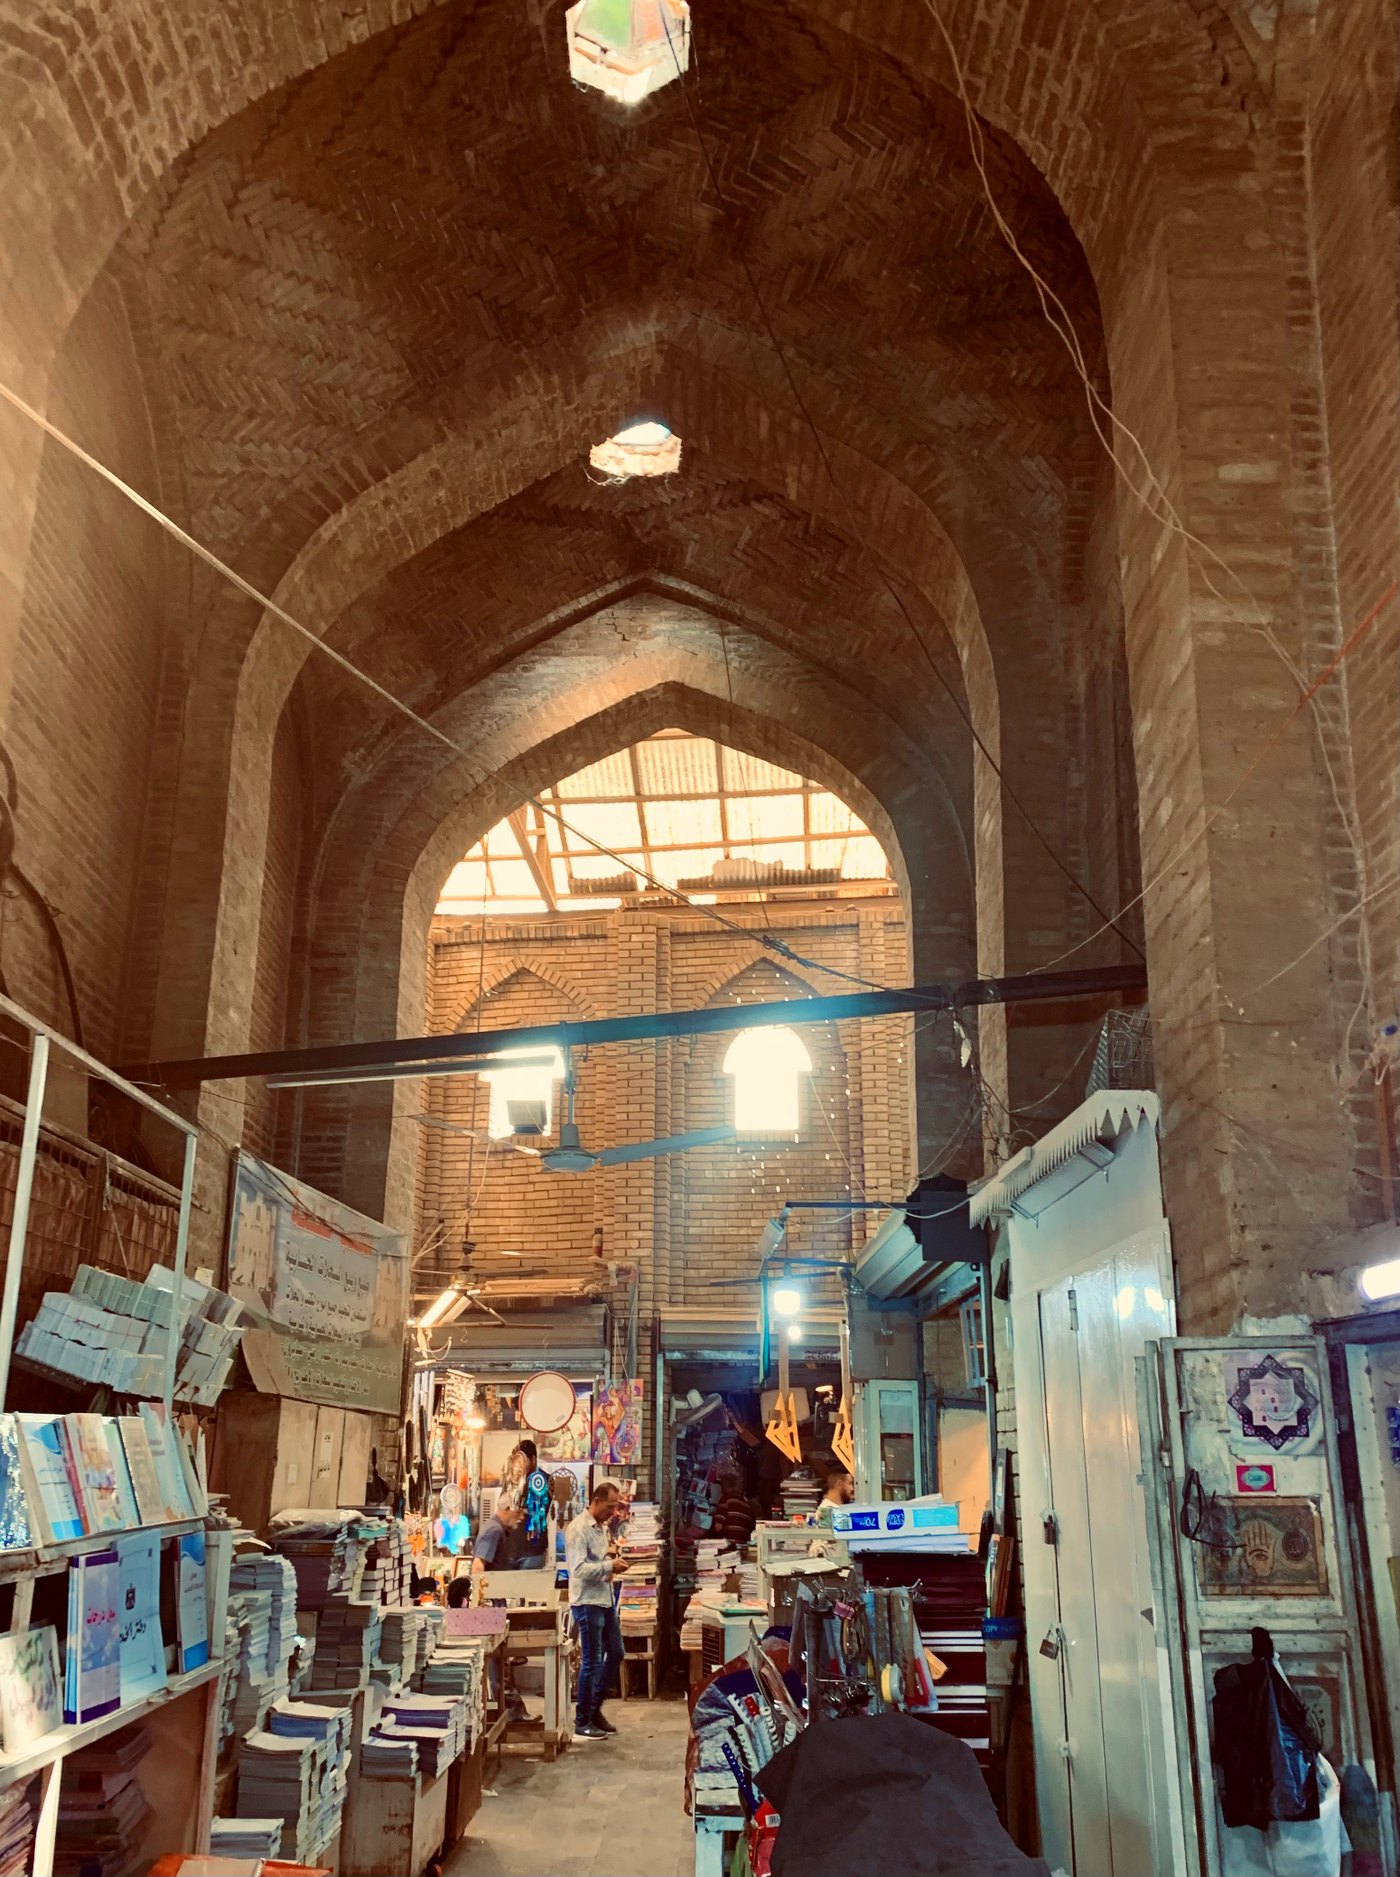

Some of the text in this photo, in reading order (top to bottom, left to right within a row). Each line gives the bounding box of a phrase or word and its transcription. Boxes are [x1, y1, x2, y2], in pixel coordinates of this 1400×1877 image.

[866, 1517, 877, 1527] 70
[118, 1618, 146, 1643] دفتر الخد
